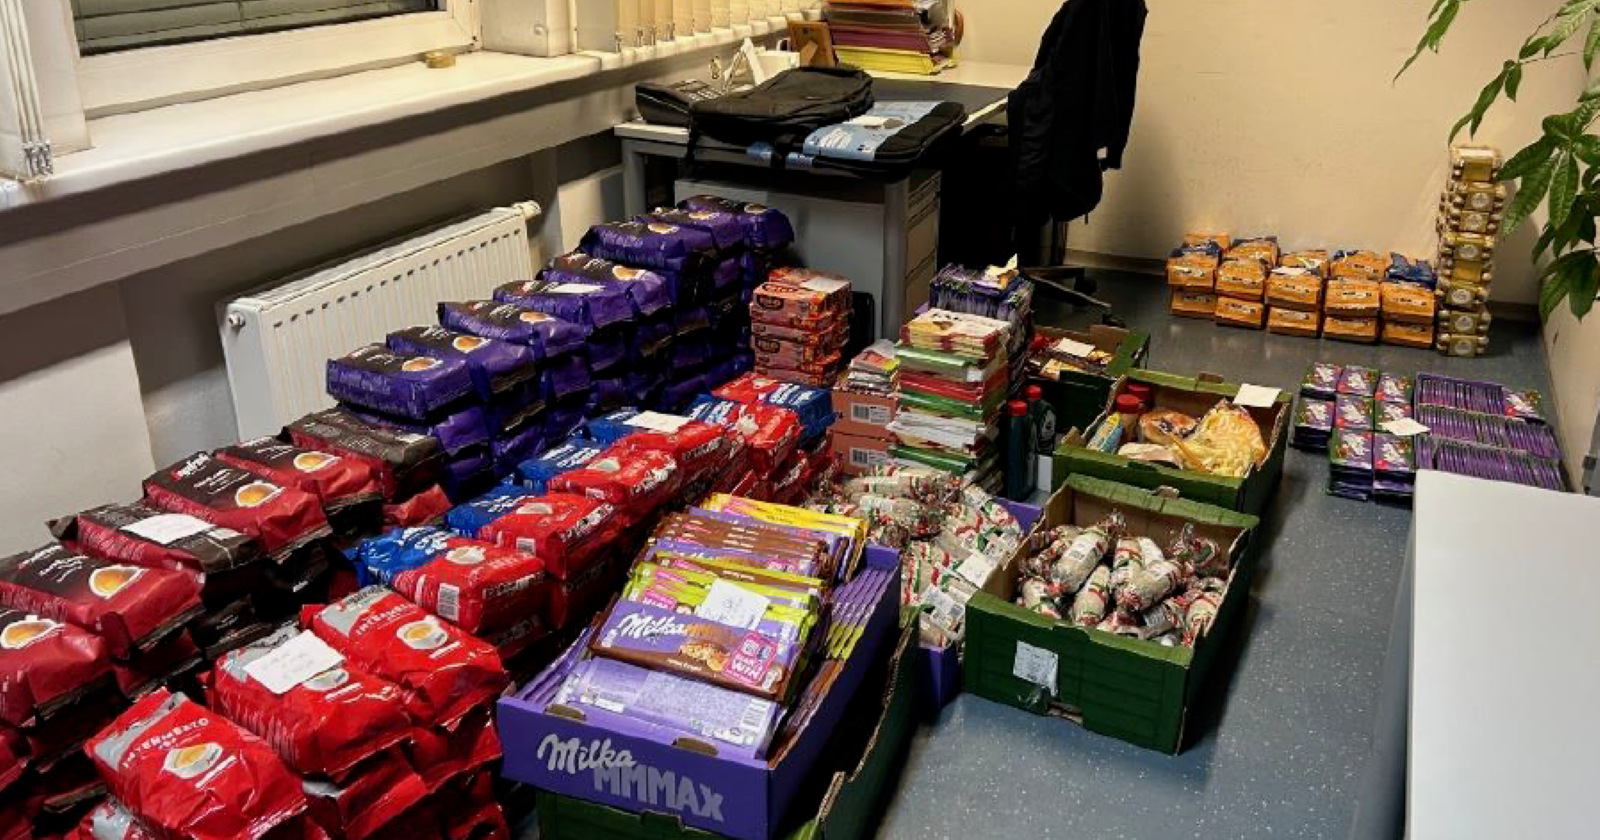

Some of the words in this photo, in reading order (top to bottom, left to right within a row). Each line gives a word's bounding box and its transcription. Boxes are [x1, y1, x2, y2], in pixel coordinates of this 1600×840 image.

[617, 612, 684, 639] Milka
[536, 733, 638, 775] Milka
[593, 764, 725, 823] MMMAX
